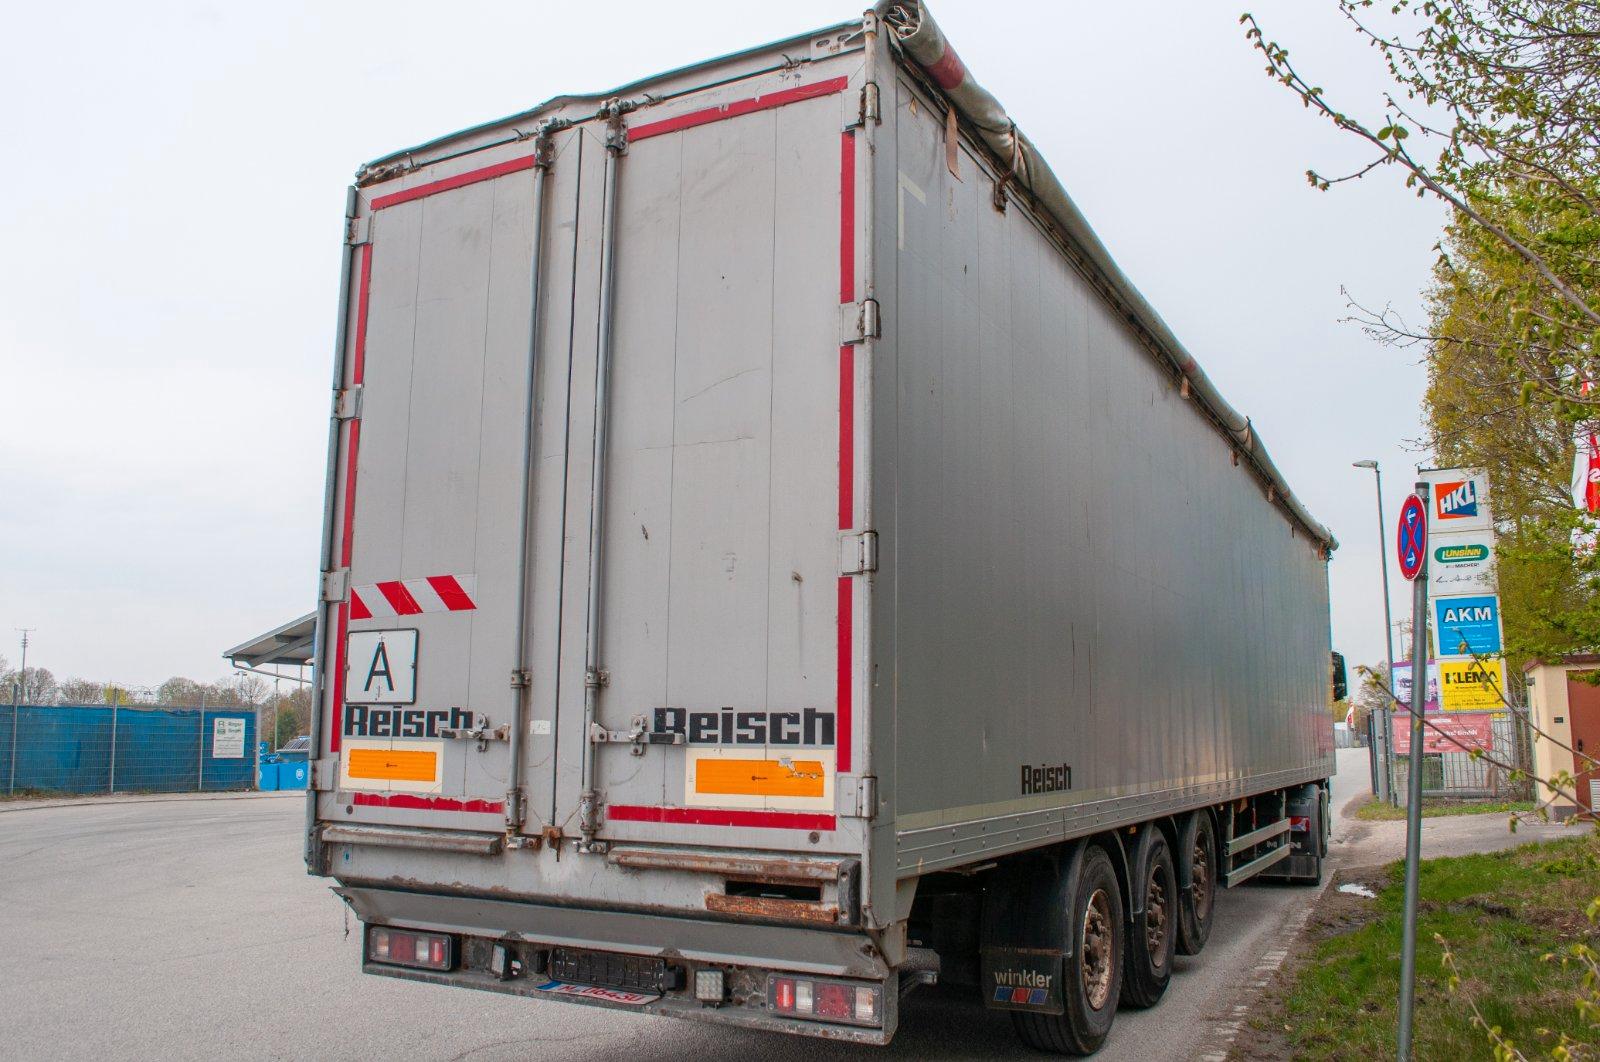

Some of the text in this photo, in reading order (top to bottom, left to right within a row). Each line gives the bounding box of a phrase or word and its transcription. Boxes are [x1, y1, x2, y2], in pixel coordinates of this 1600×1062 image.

[1440, 481, 1475, 514] HKL
[1443, 606, 1492, 623] AKM
[364, 641, 394, 692] A
[344, 705, 474, 738] Reisch
[654, 706, 835, 745] Reisch
[1021, 762, 1072, 796] Reisch
[994, 968, 1052, 988] winkler
